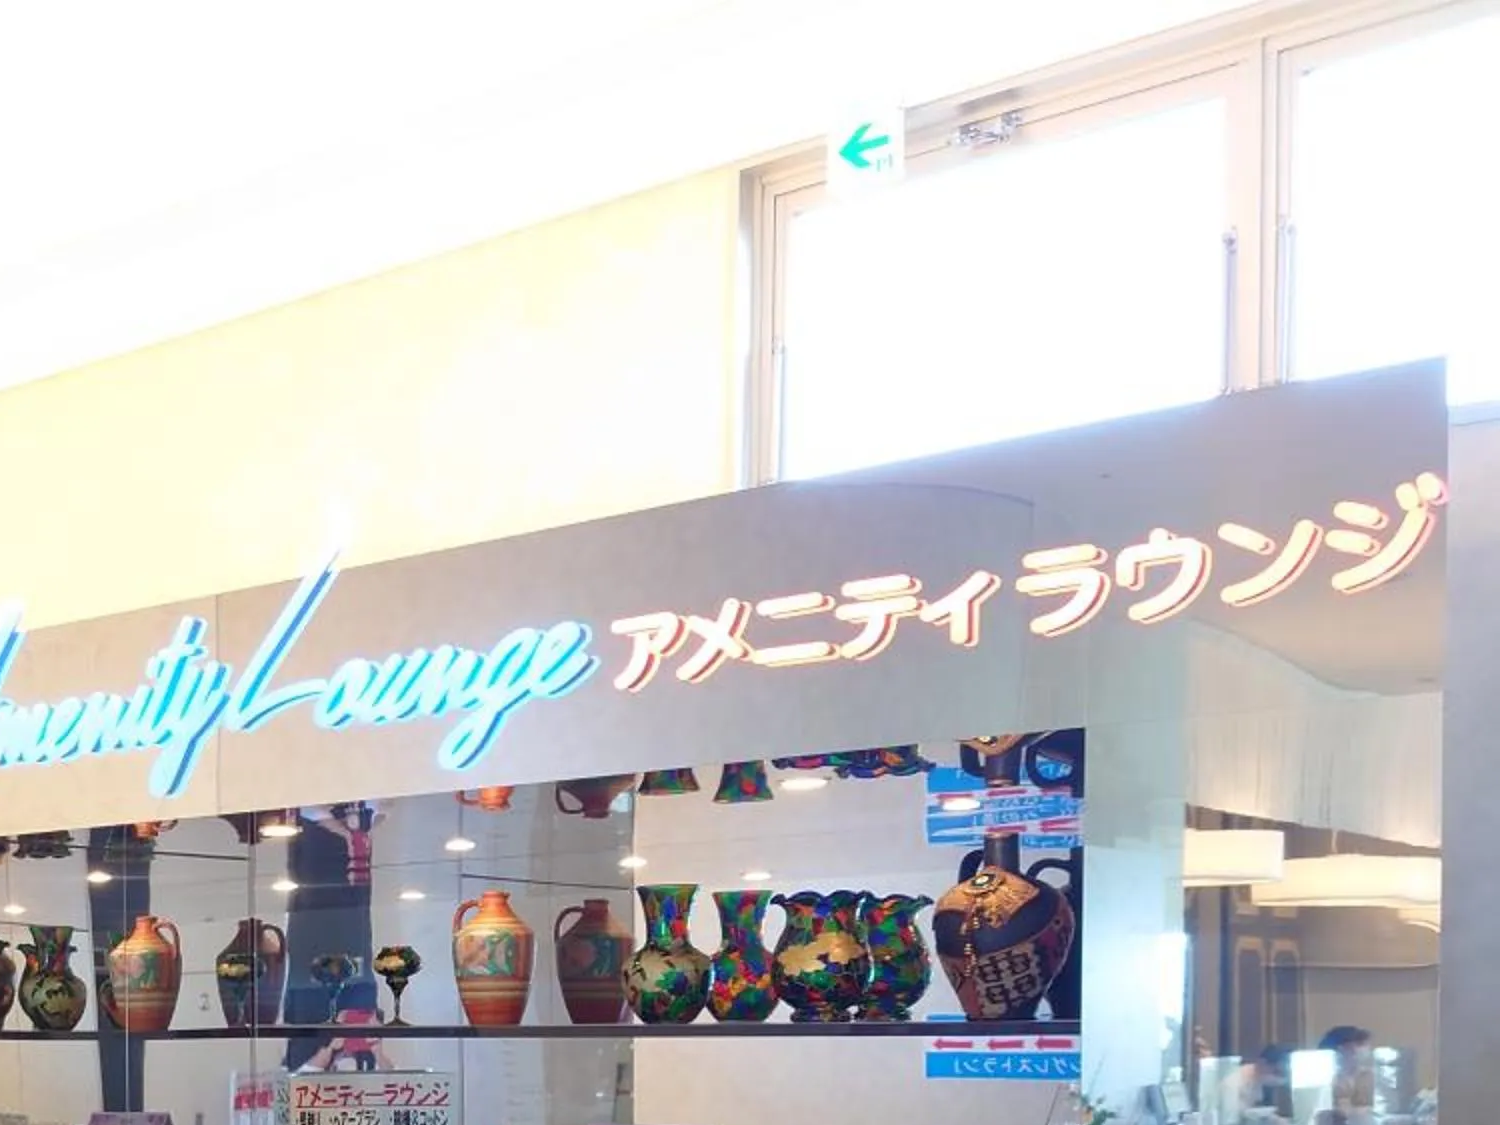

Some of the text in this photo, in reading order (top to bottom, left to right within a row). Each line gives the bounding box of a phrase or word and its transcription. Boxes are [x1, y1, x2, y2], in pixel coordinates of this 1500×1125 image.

[220, 538, 600, 770] Lounge
[296, 1081, 450, 1106] アメニティーラウンジ
